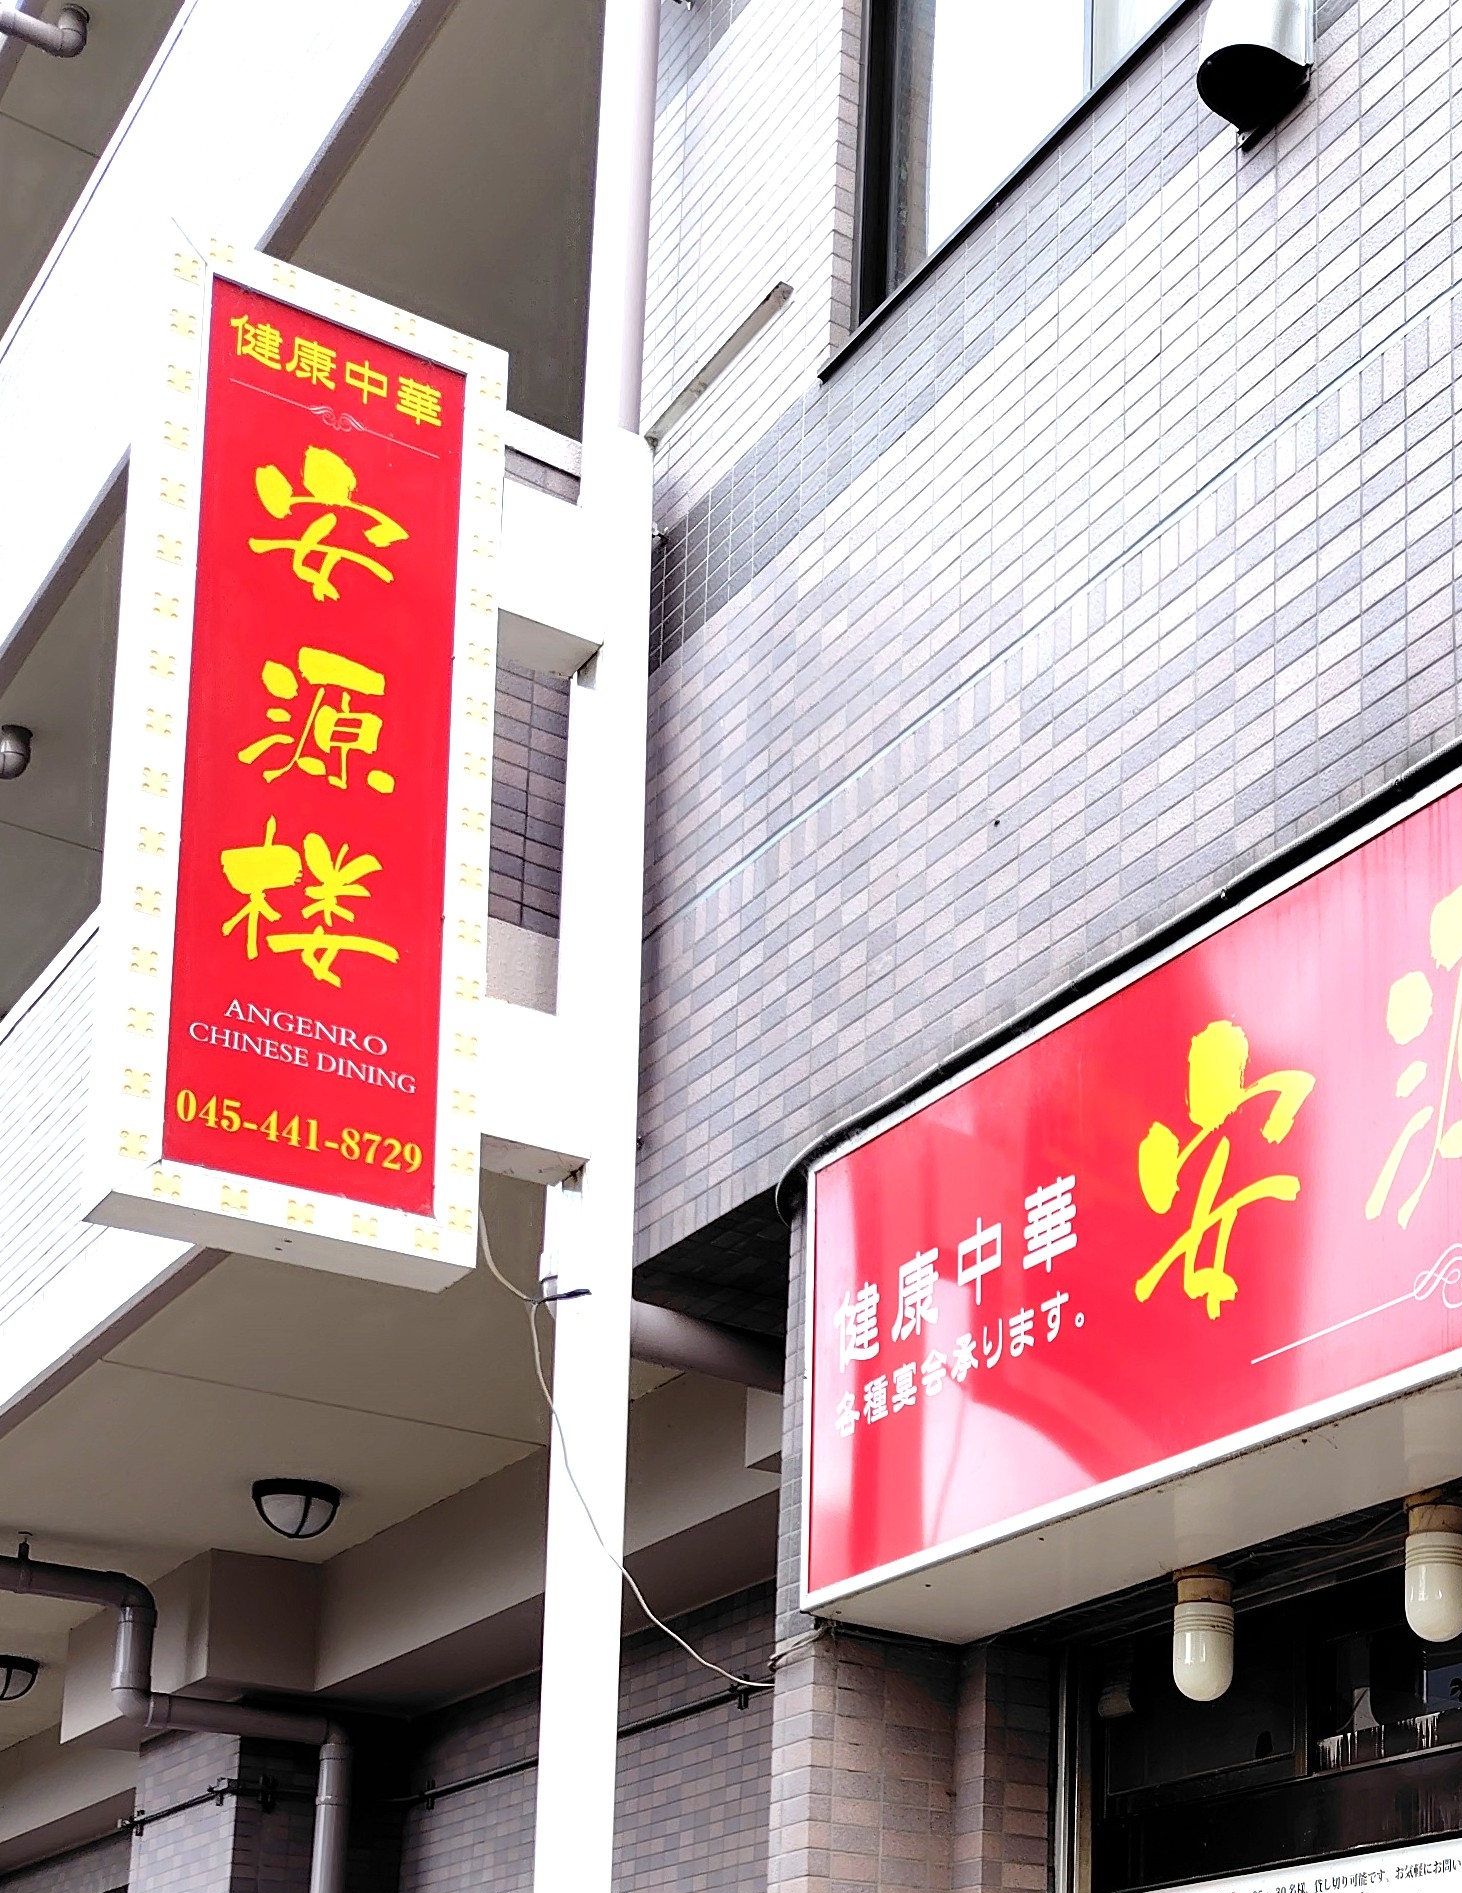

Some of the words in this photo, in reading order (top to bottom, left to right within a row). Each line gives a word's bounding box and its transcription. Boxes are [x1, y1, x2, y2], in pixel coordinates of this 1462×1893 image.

[229, 313, 442, 428] 健康中華
[221, 446, 411, 987] 安源楼
[189, 1022, 308, 1067] CHINESE
[317, 1053, 417, 1094] DINING
[224, 998, 388, 1056] ANGENRO
[176, 1088, 423, 1174] 045-441-8729
[833, 1174, 1077, 1374] 健康中華
[835, 1291, 1085, 1439] 各種宴会承ります。
